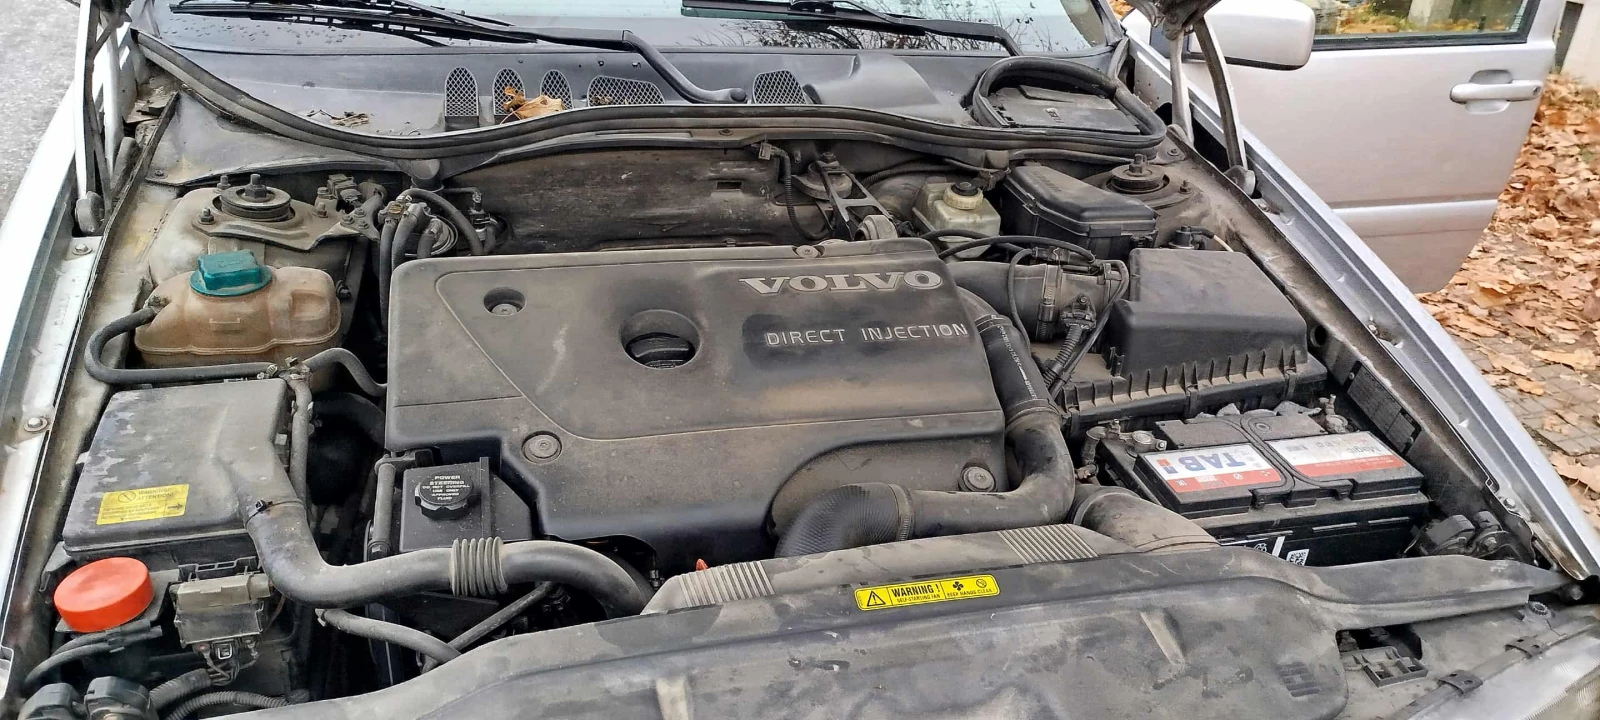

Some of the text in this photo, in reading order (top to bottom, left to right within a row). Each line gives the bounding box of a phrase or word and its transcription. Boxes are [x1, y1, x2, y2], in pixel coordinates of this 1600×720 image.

[738, 270, 942, 295] VOLVO
[764, 323, 969, 347] DIRECT INJECTION
[1178, 452, 1246, 471] TAB
[891, 585, 934, 598] WARNING
